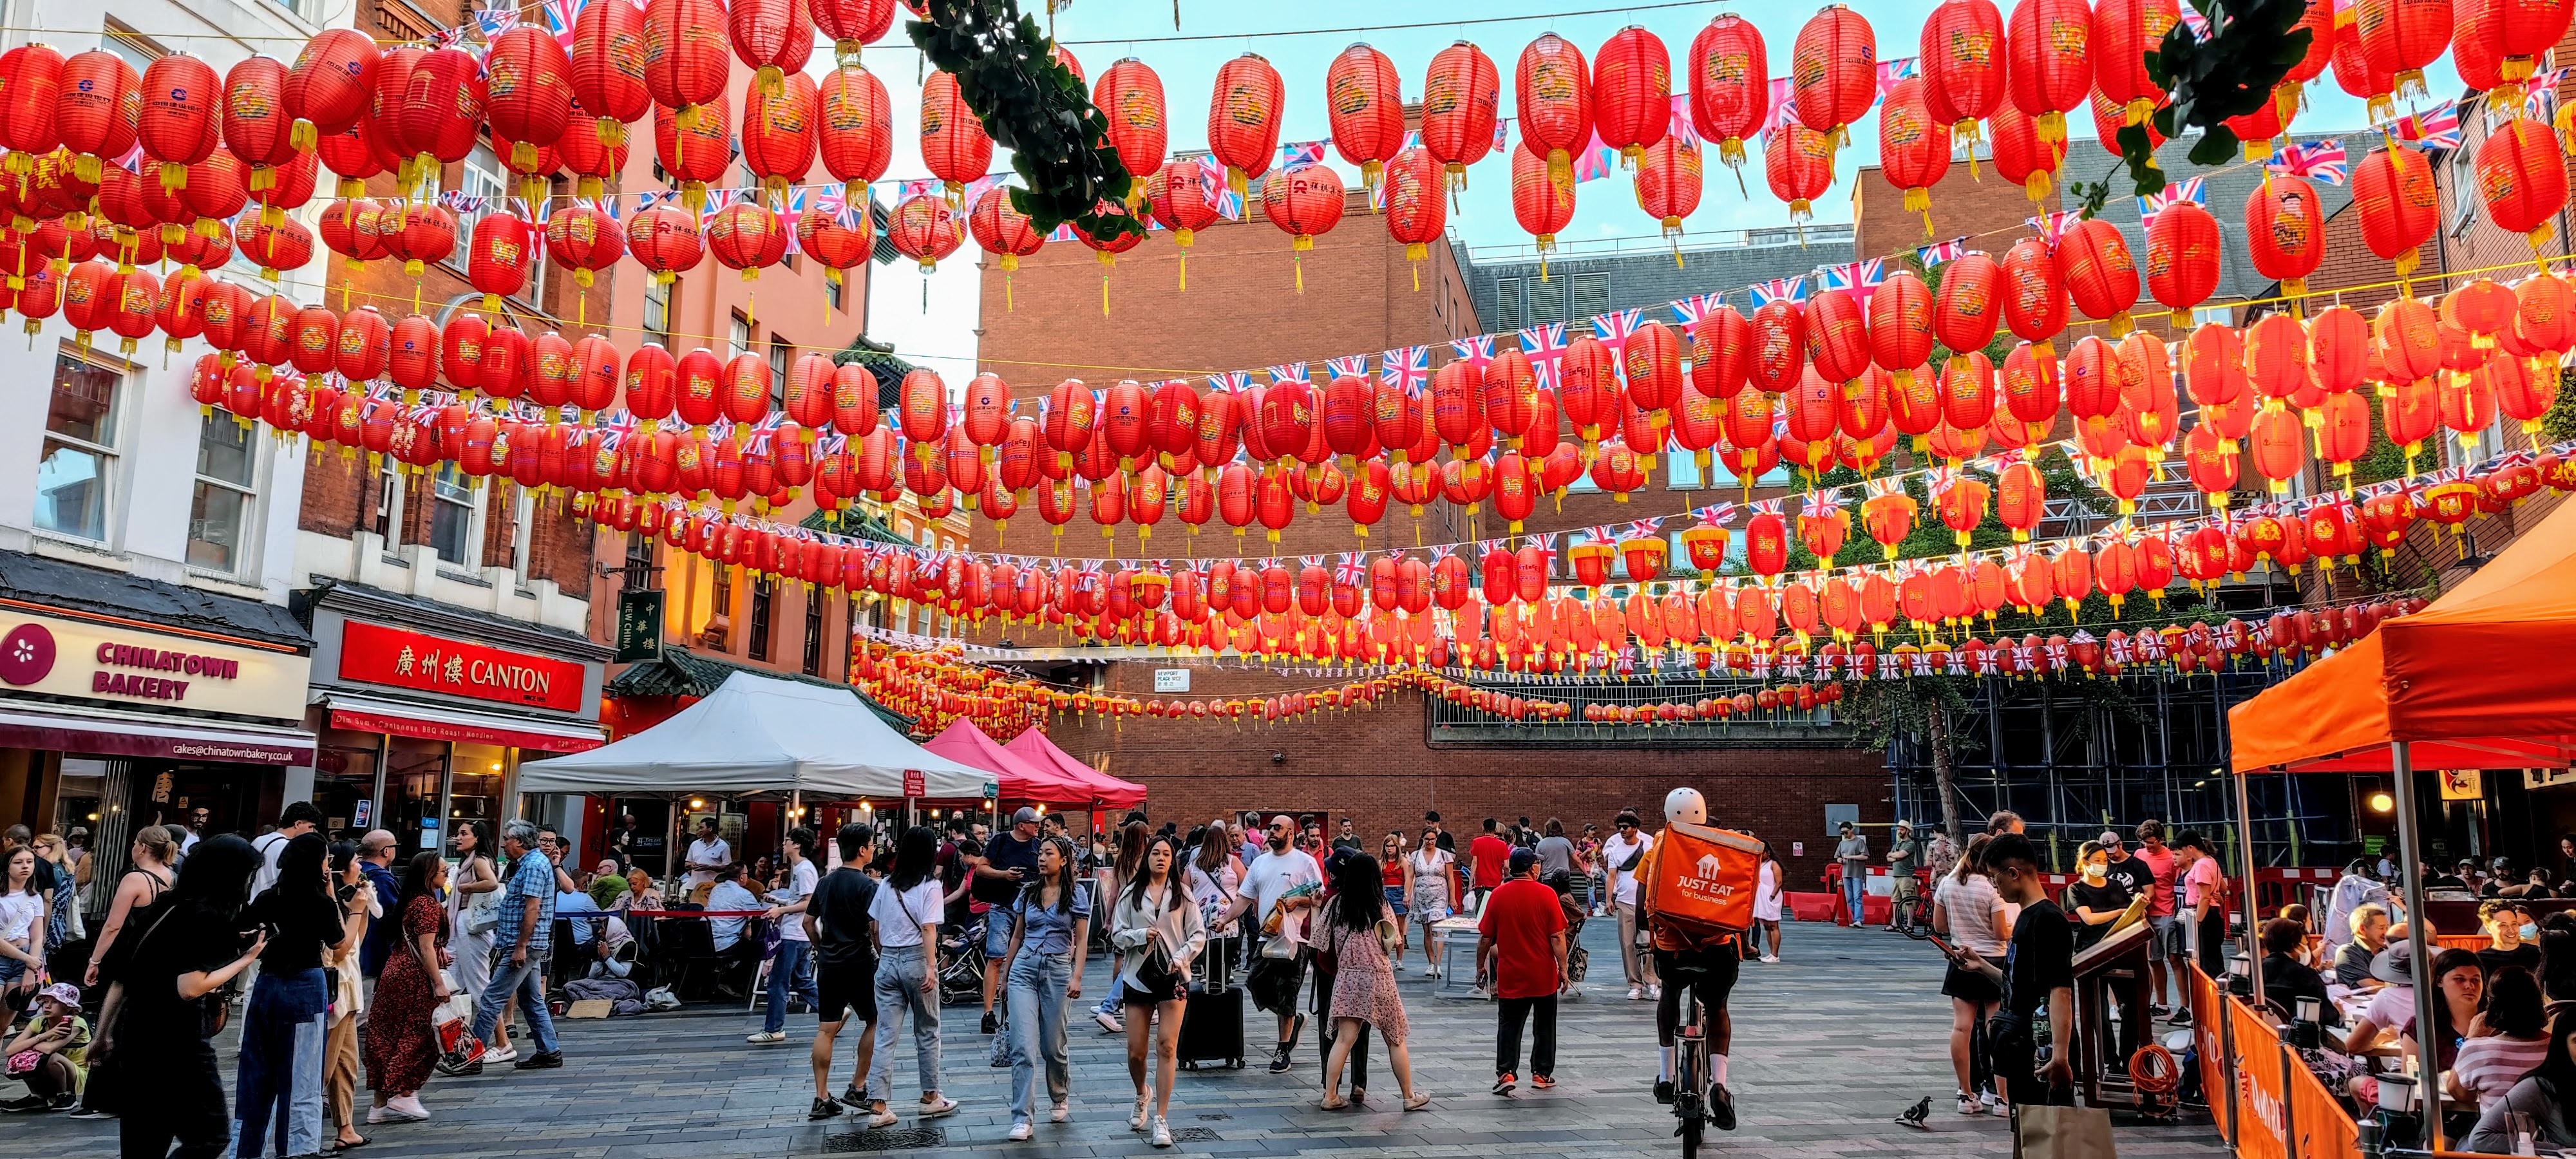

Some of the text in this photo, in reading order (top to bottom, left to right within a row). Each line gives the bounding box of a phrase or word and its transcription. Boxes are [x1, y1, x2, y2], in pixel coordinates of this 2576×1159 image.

[623, 603, 633, 650] NEW CHINA
[636, 603, 656, 650] 中華樓
[97, 642, 239, 679] CHINATOWN
[395, 645, 464, 686] 廣州樓
[471, 659, 550, 694] CANTON
[92, 670, 189, 700] BAKERY
[355, 717, 370, 726] Sum
[378, 721, 418, 732] Cantonese
[422, 726, 437, 734] BBQ
[440, 728, 460, 737] Roast
[466, 731, 493, 740] Noodles
[173, 743, 294, 762] cakes@chinatownbakery.co.uk
[1676, 875, 1734, 896] JUST EAT
[1681, 889, 1727, 905] for business
